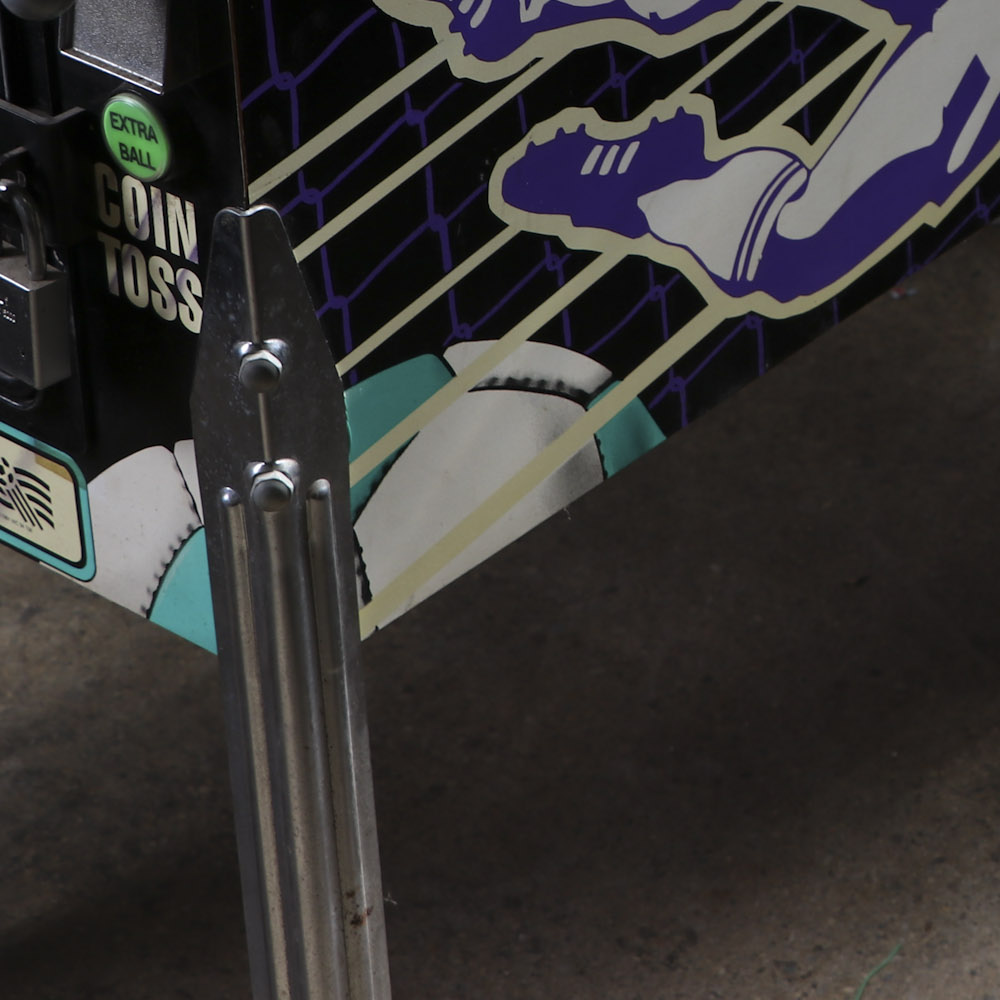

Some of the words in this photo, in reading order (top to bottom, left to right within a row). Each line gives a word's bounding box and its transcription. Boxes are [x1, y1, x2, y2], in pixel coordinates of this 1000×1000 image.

[109, 110, 160, 145] EXTRA
[118, 141, 158, 172] BALL
[93, 160, 200, 266] COIN
[96, 230, 204, 335] TOSS
